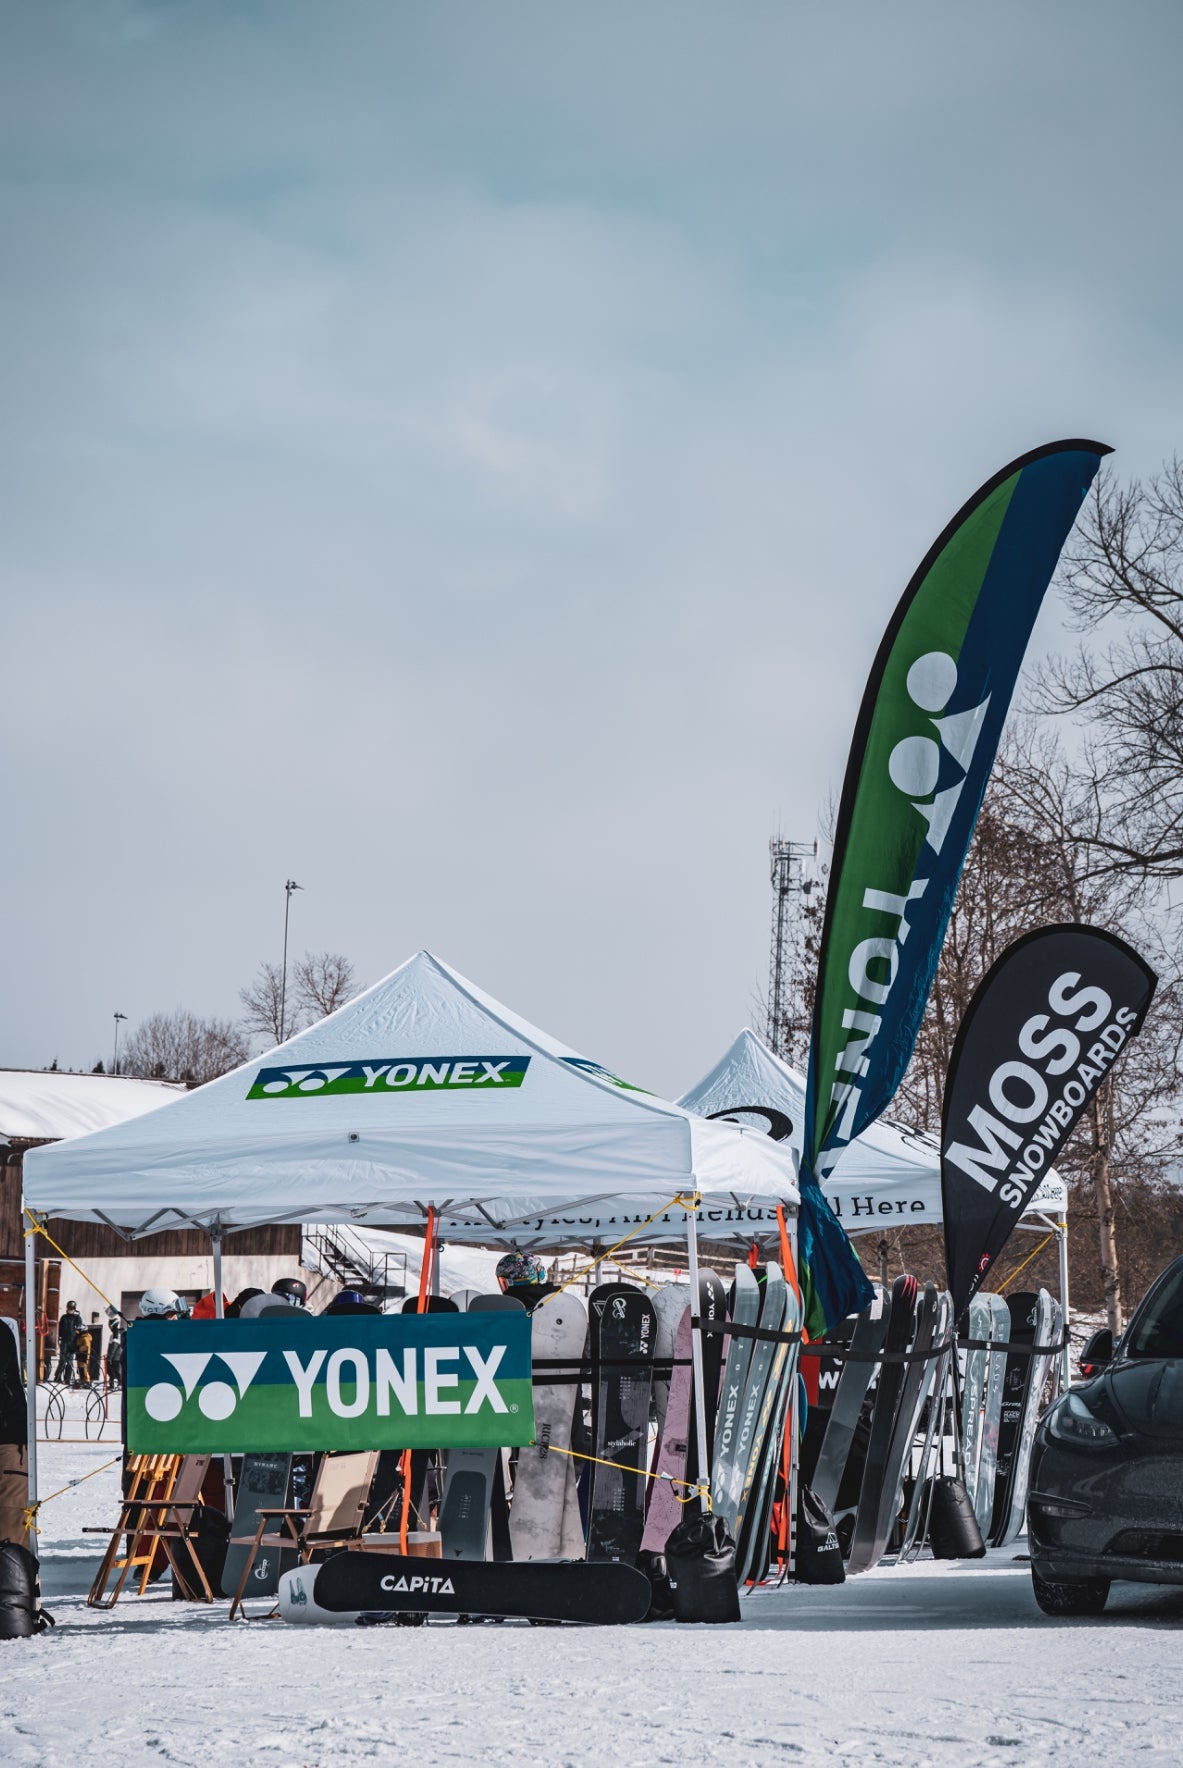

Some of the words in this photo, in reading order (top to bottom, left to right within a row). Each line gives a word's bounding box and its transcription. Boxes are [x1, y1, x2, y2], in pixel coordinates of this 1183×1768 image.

[362, 1061, 511, 1087] YONEX
[944, 971, 1112, 1193] MOSS
[1000, 1006, 1138, 1209] SNOWBOARDS
[851, 1196, 926, 1216] Here
[640, 1313, 651, 1339] YONEX
[282, 1345, 510, 1418] YONEX
[719, 1384, 740, 1458] YONEX
[737, 1384, 761, 1456] YONEX
